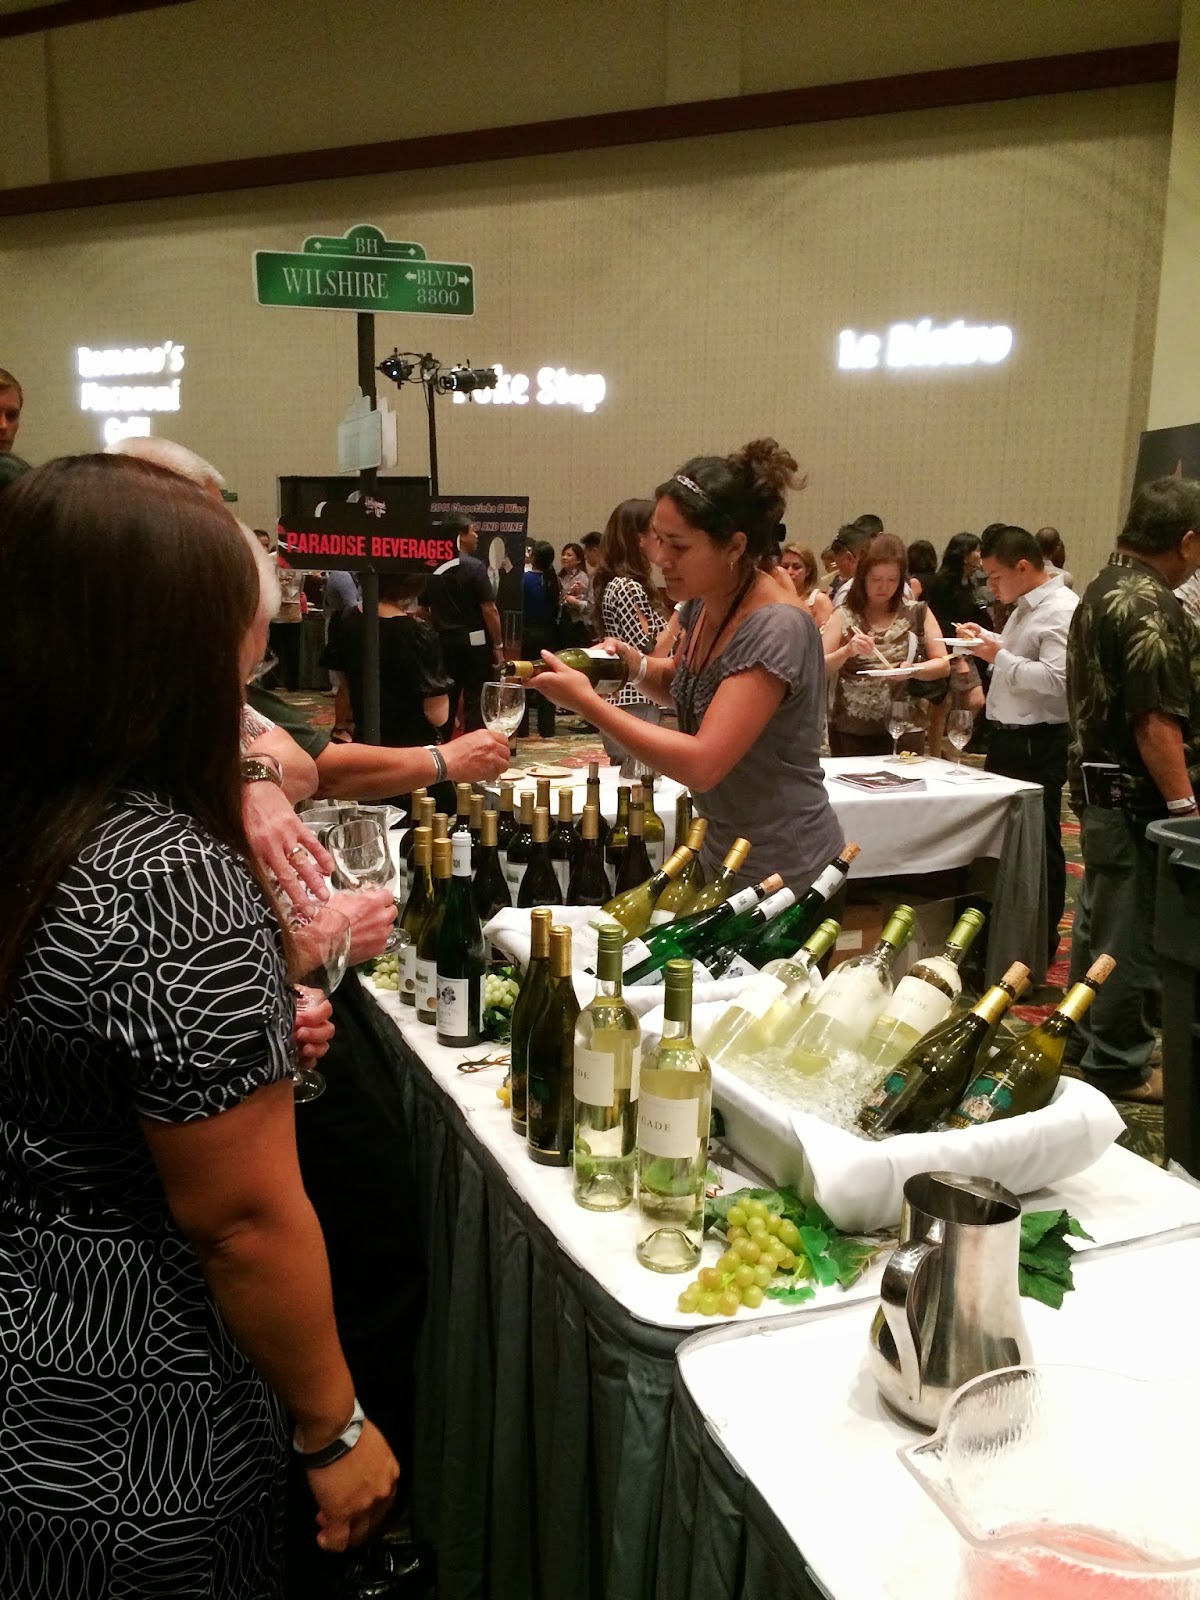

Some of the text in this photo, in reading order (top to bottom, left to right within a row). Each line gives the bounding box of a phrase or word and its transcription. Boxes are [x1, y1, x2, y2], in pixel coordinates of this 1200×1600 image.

[355, 237, 378, 255] BH
[282, 267, 389, 299] WILSHIRE
[416, 269, 458, 287] BLVD
[417, 288, 460, 306] 8800
[536, 366, 606, 412] Stop
[505, 502, 527, 513] Wine
[481, 521, 499, 532] AND
[500, 521, 524, 532] WINE
[286, 532, 454, 560] PARADISE BEVERAGES
[641, 1116, 671, 1132] CADE
